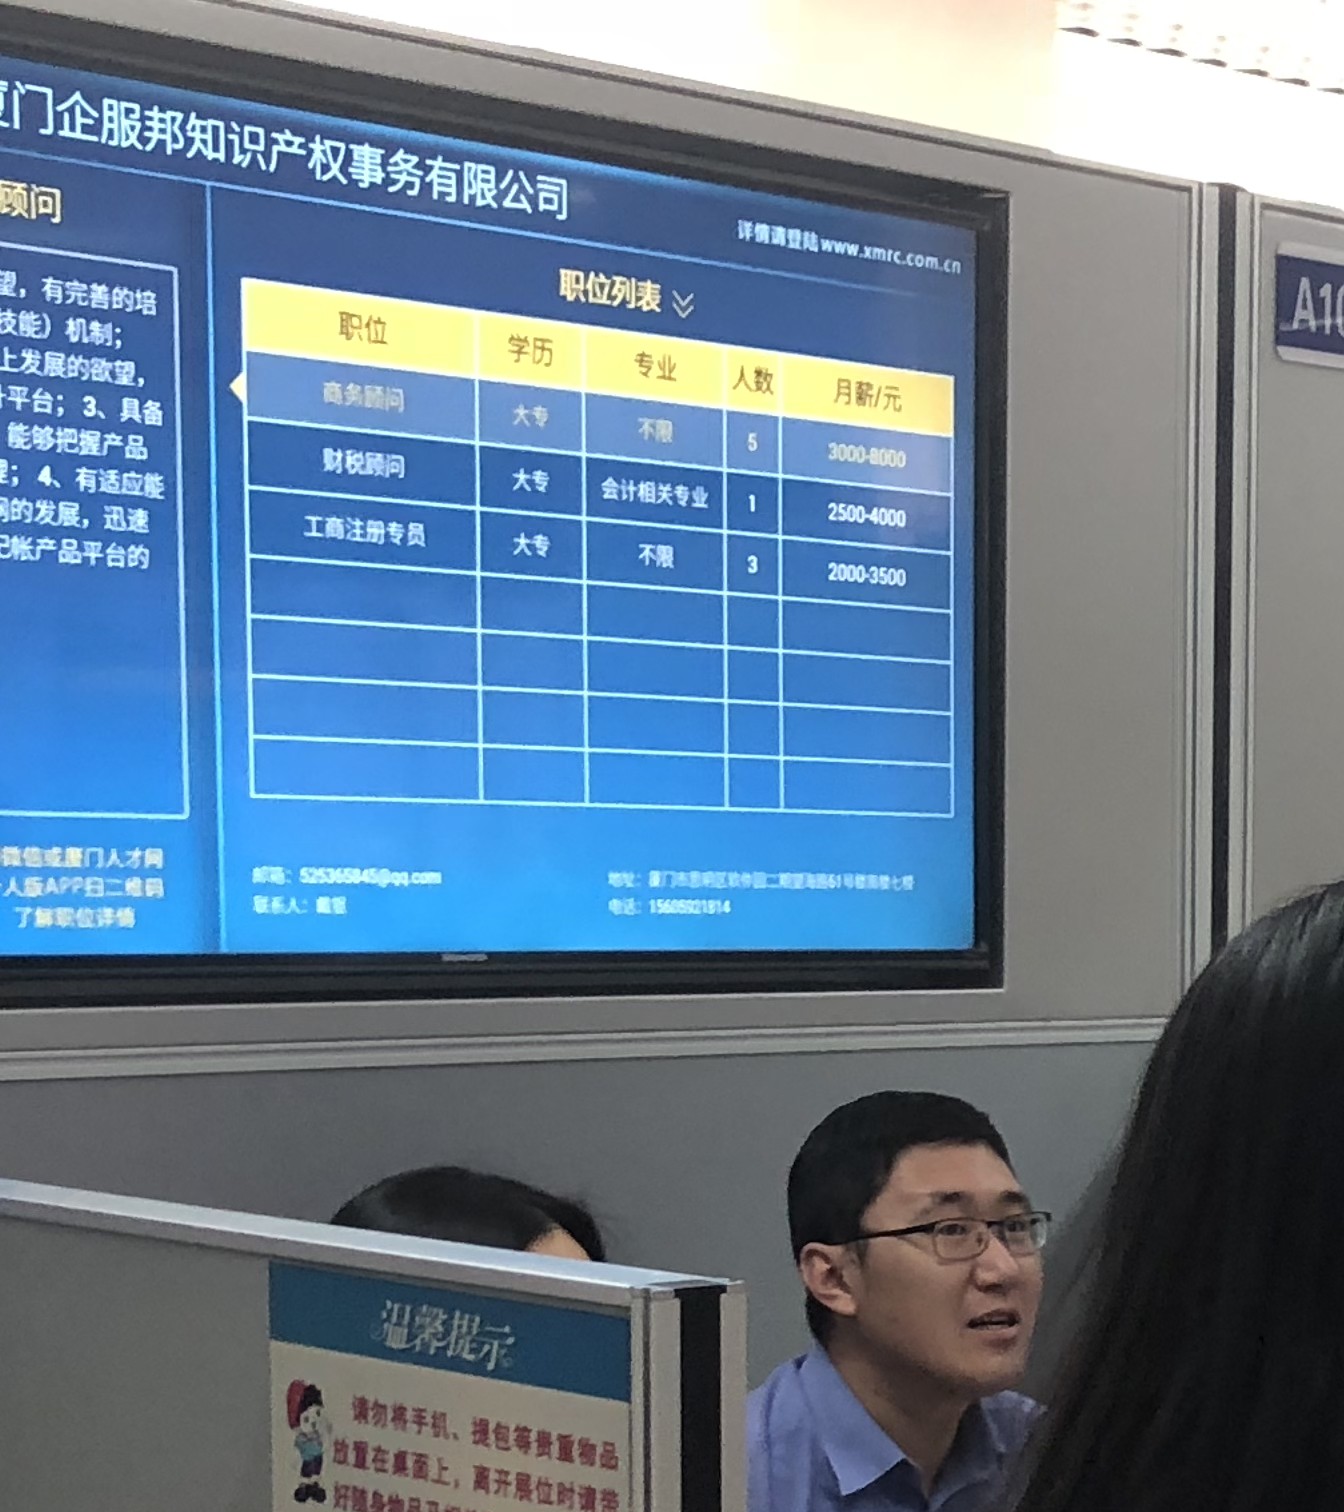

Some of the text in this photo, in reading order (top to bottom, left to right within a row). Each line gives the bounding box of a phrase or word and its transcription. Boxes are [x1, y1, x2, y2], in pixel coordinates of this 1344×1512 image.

[0, 80, 569, 221] 门企服邦知识产权事务有限公司
[0, 180, 61, 223] 顾问
[559, 269, 661, 314] 职位列表
[338, 310, 389, 347] 职位
[507, 333, 554, 369] 学历
[633, 351, 678, 383] 专业
[732, 364, 775, 396] 人数
[834, 377, 903, 413] 月薪/元
[0, 385, 164, 427] 平台；3、具备
[512, 404, 550, 429] 大专
[7, 422, 149, 461] 能够把握产品
[637, 417, 674, 444] 不限
[747, 433, 758, 452] 5
[322, 447, 405, 479] 财税顾问
[512, 468, 550, 493] 大专
[600, 476, 710, 509] 会计相关专业
[748, 494, 756, 513] 1
[828, 503, 907, 529] 2500-4000
[303, 515, 427, 548] 工商注册专员
[512, 535, 551, 559] 大专
[637, 543, 675, 570] 不限
[747, 556, 758, 575] 3
[828, 563, 907, 588] 2000-3500
[373, 1298, 517, 1371] 温馨提示
